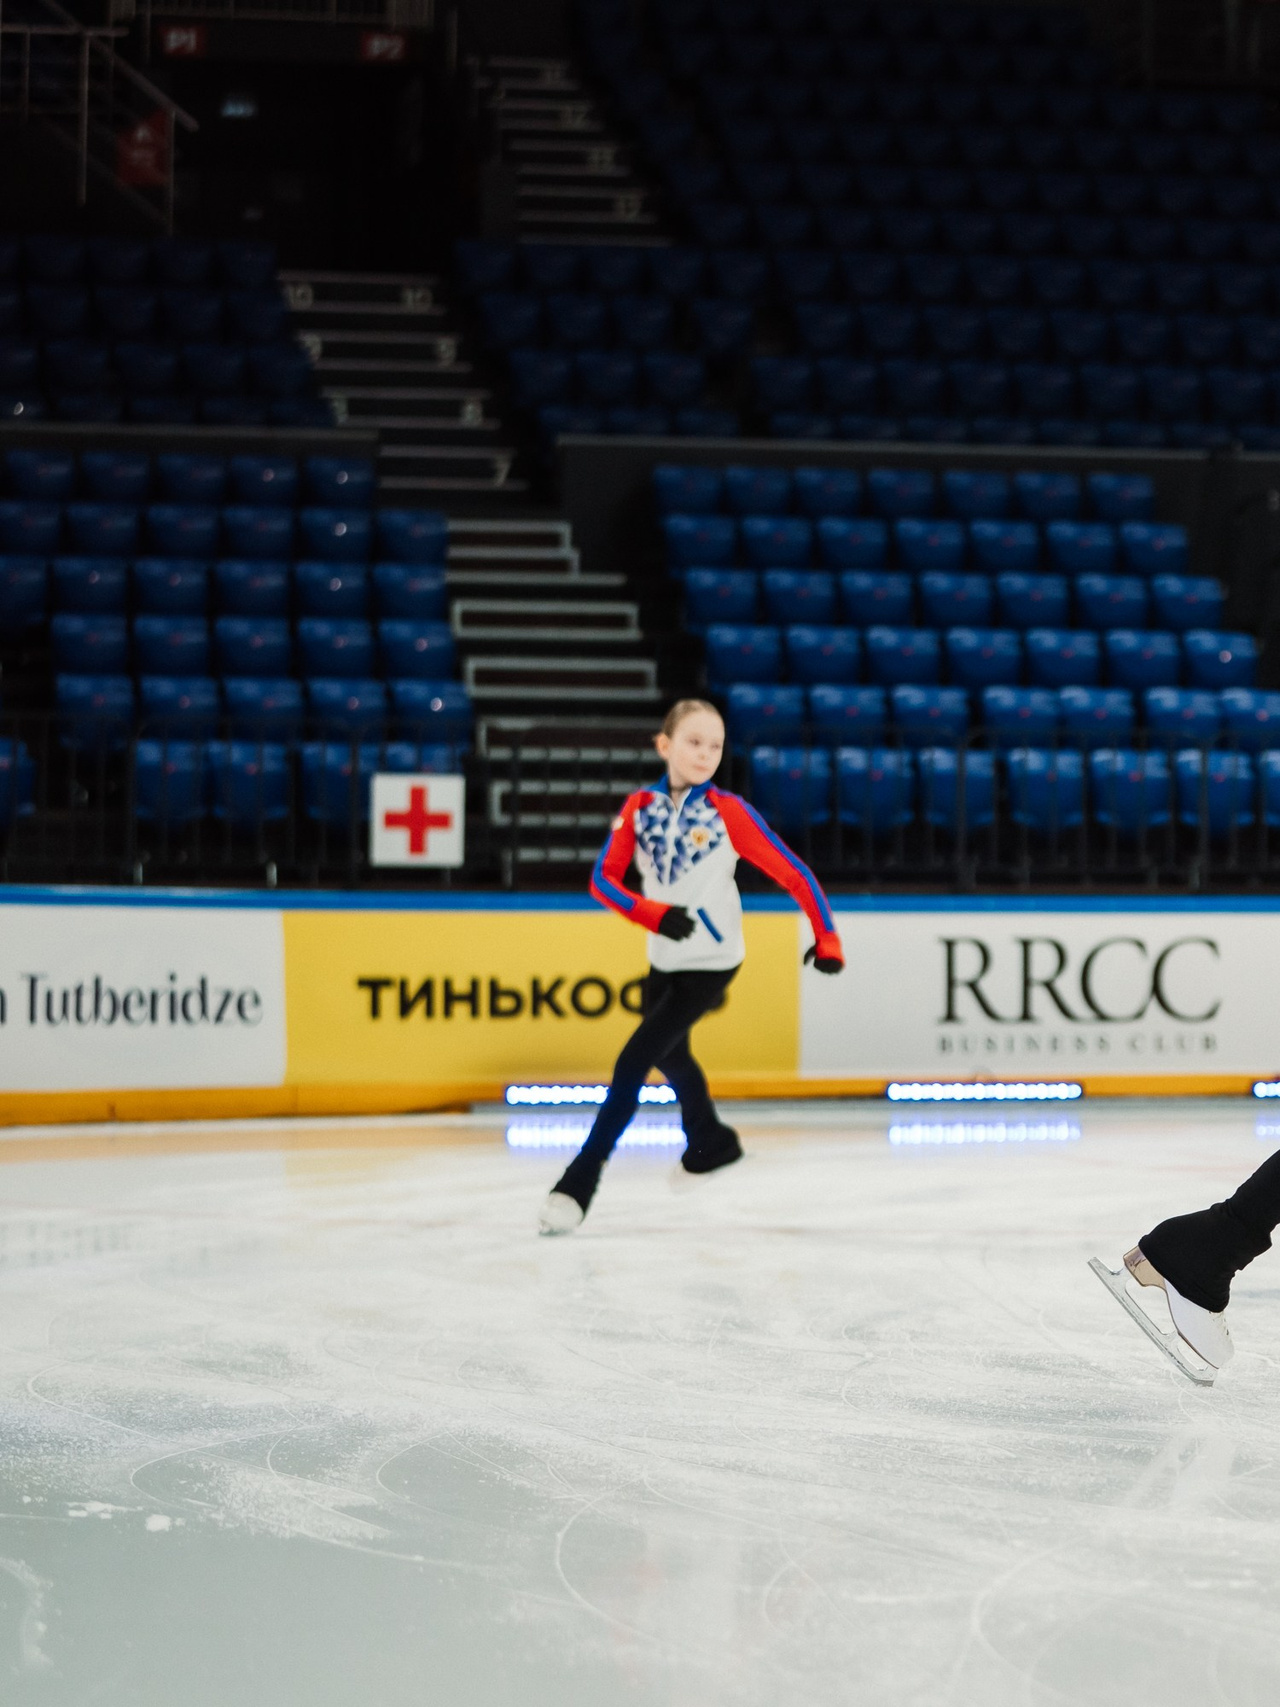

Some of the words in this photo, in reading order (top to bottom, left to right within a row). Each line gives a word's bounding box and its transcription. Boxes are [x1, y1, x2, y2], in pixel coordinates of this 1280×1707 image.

[22, 970, 263, 1026] Tutberidze
[937, 936, 1221, 1025] RRCC
[937, 1034, 1110, 1055] BUSINESS
[1127, 1033, 1219, 1055] CLUB
